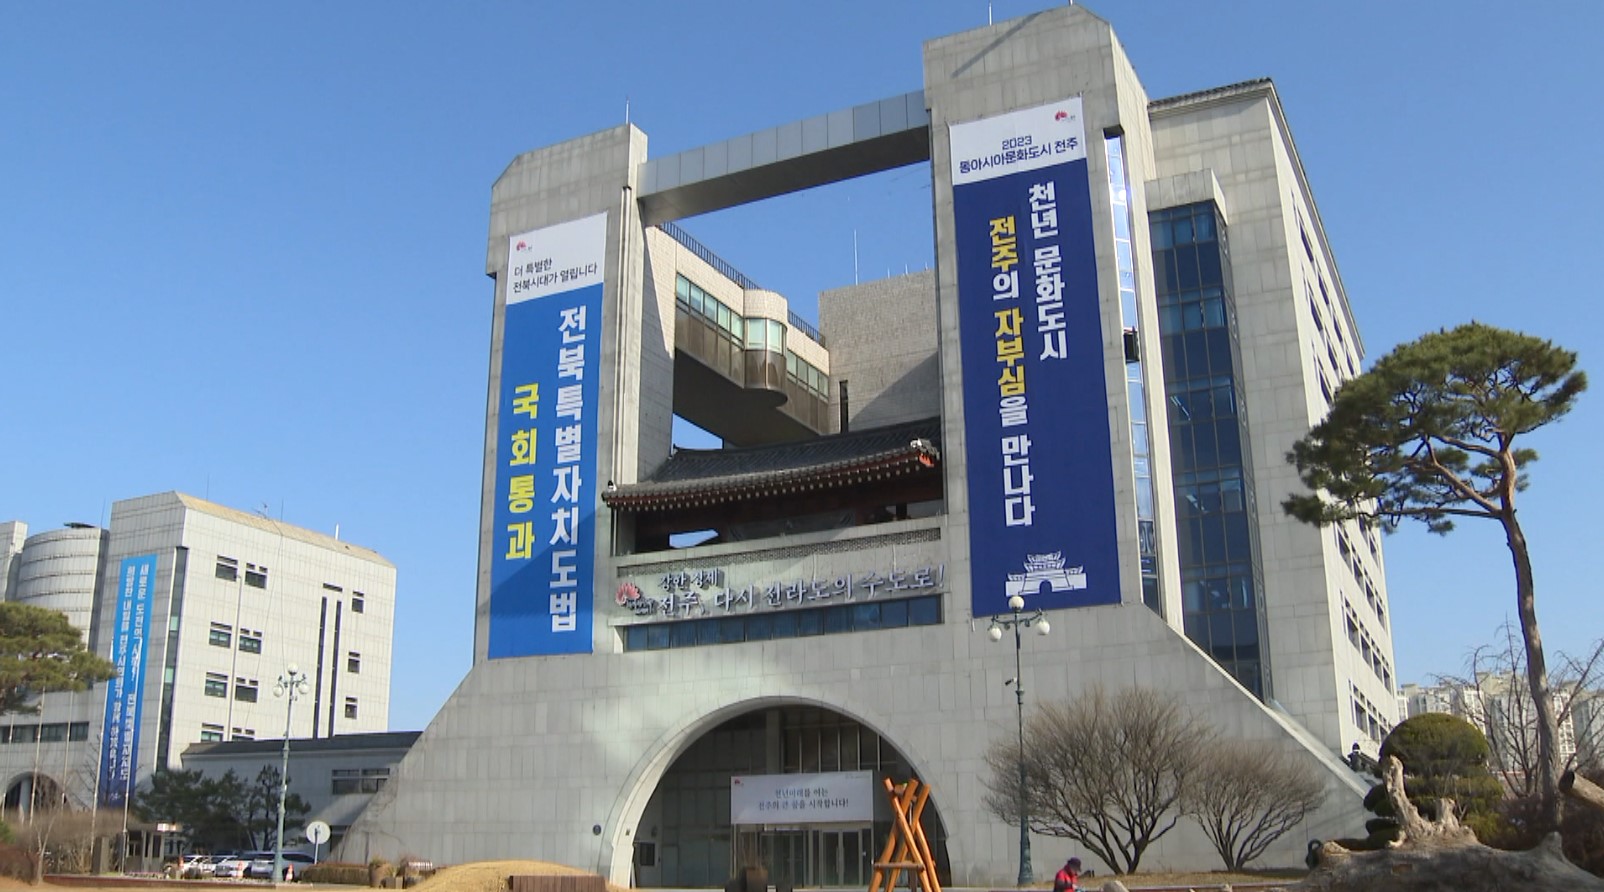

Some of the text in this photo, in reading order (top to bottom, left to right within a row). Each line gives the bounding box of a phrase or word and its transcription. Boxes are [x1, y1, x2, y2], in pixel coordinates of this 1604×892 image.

[959, 136, 1079, 174] 동아시아문화도시 전주
[1002, 135, 1033, 150] 2023
[513, 262, 598, 293] 전북시대가 열립니다
[514, 257, 552, 277] 더 특별한
[1028, 181, 1068, 361] 천년 문화도시
[989, 215, 1036, 527] 전주의 자부심을 만나다
[549, 305, 588, 633] 전북특별자치도법
[658, 567, 719, 592] 강한 경제
[658, 591, 706, 616] 전주,
[715, 582, 755, 611] 다시
[764, 573, 852, 607] 전라도의
[860, 562, 946, 599] 수도로!
[808, 797, 849, 810] 시작합니다!
